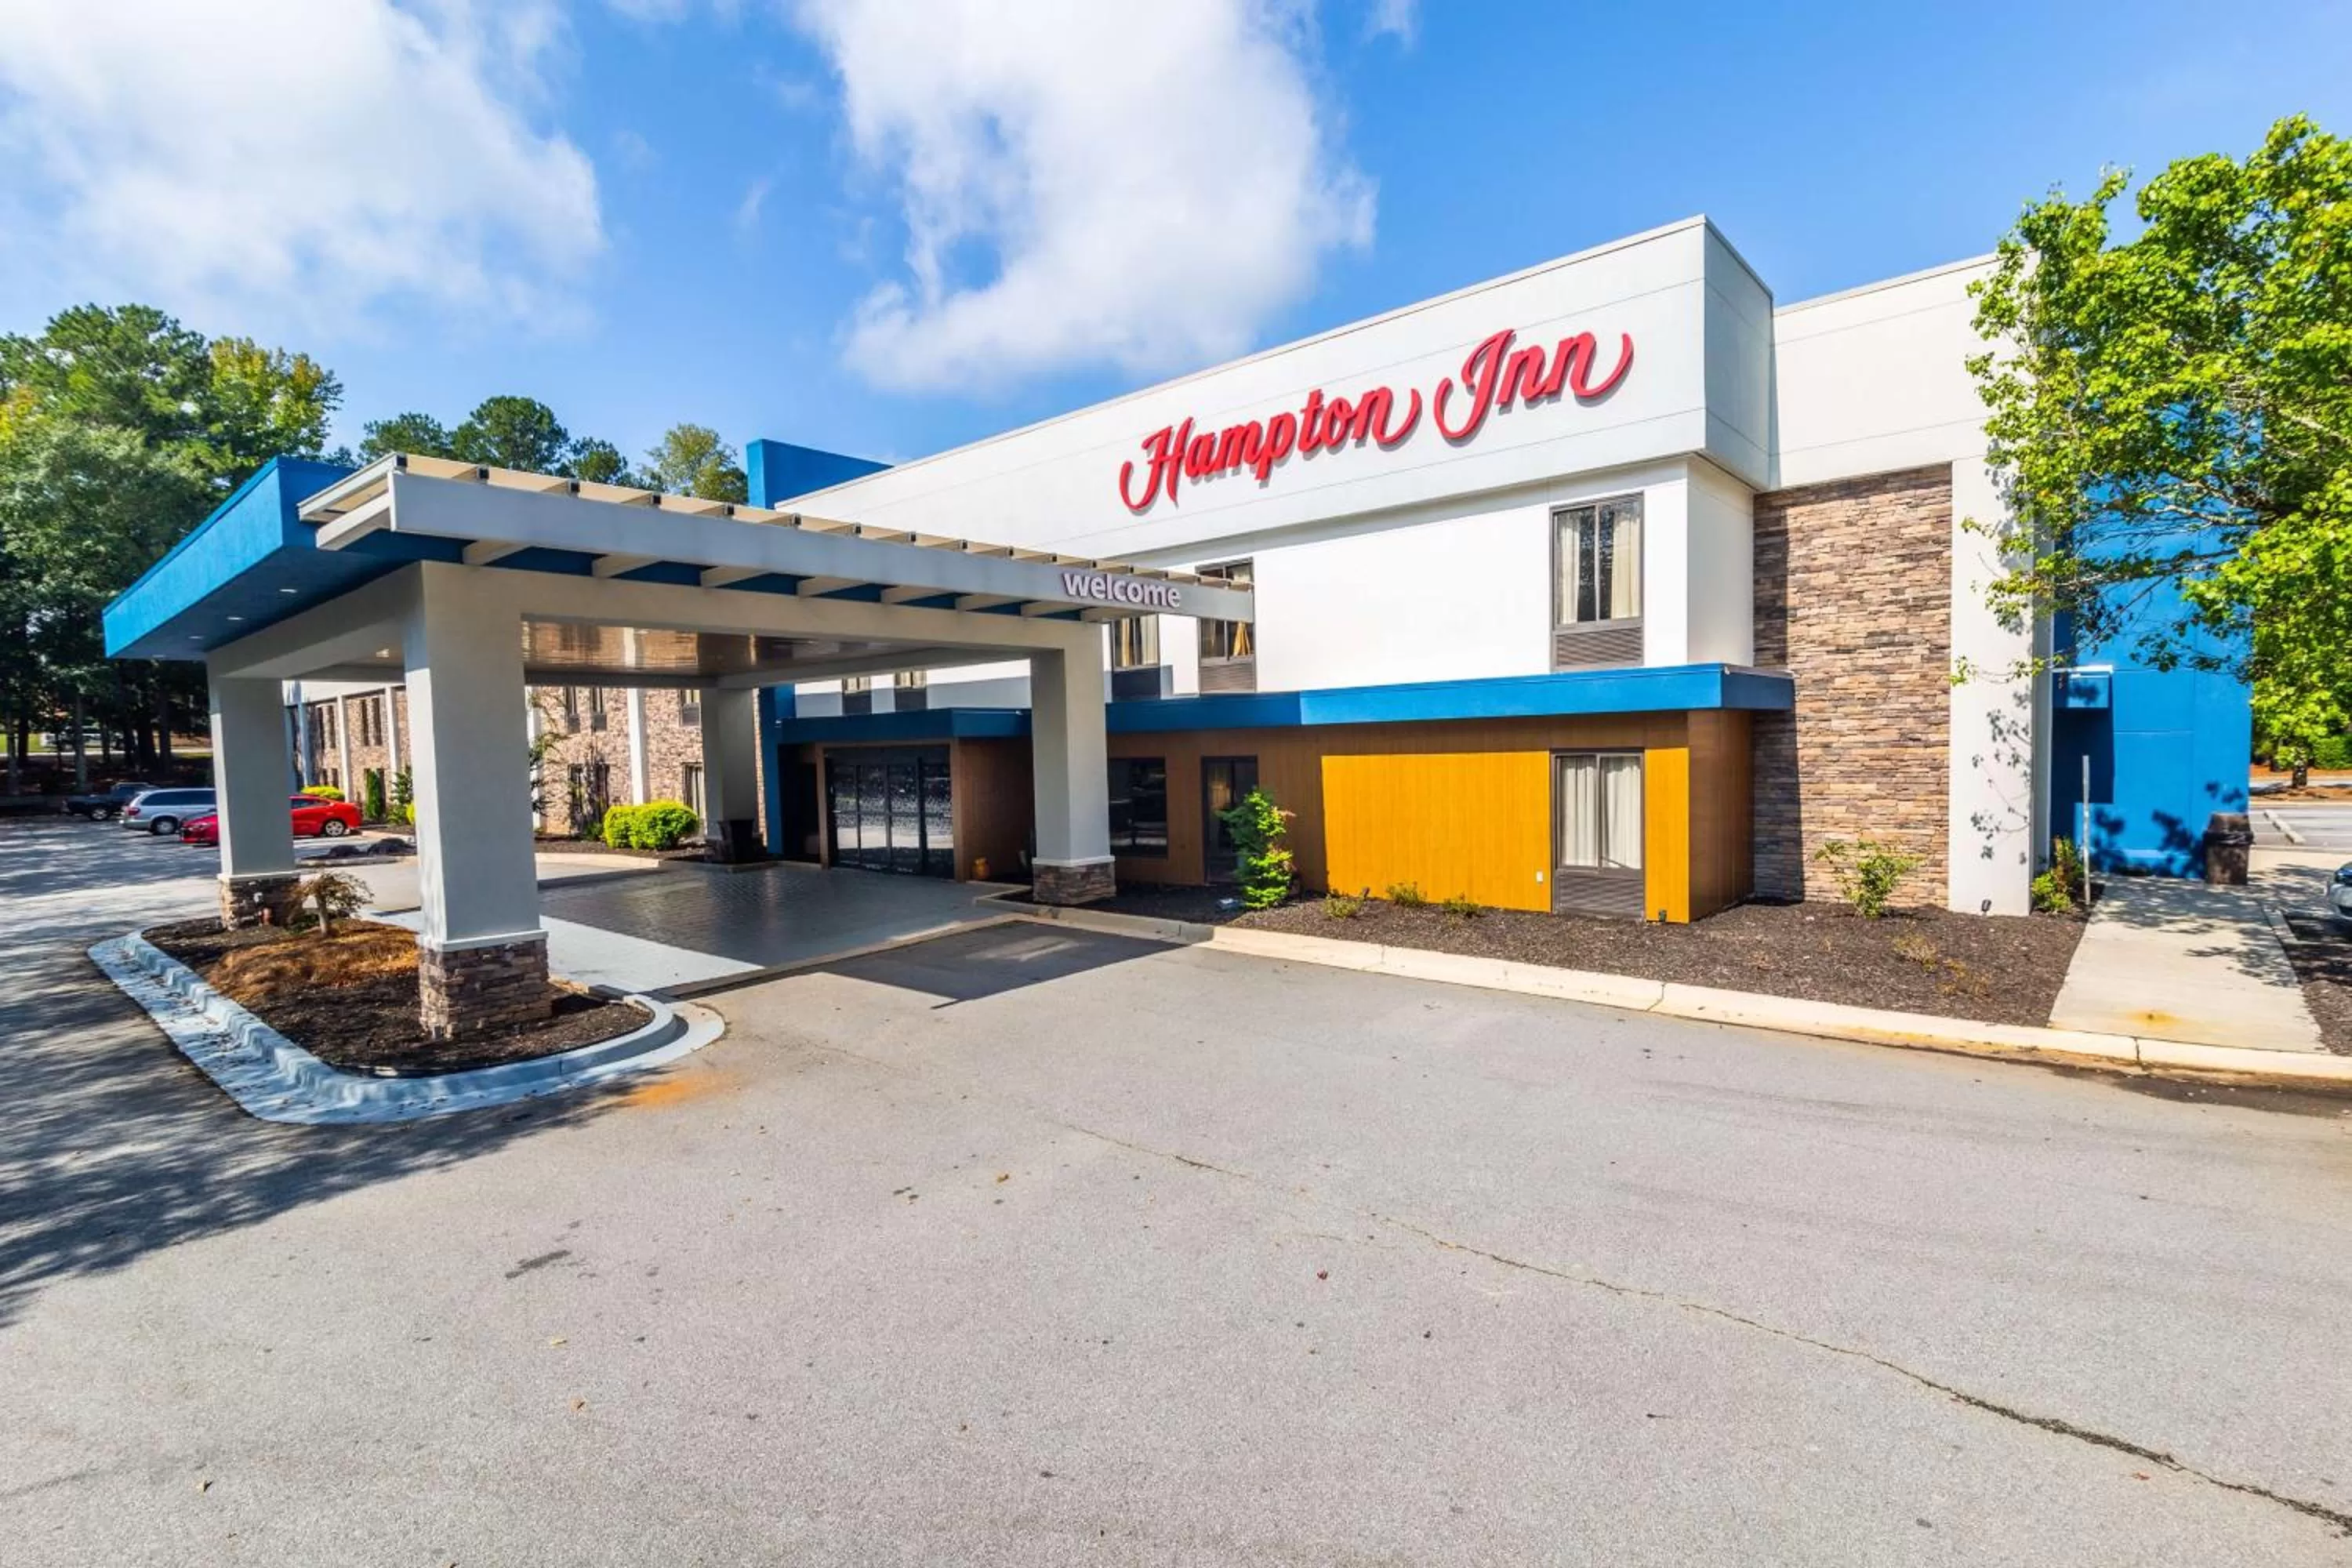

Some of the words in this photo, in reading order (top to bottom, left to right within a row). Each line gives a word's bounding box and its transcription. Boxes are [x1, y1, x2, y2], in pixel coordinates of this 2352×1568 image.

[1120, 386, 1421, 511] Hampton
[1433, 329, 1633, 439] Inn
[1062, 572, 1181, 608] welcome
